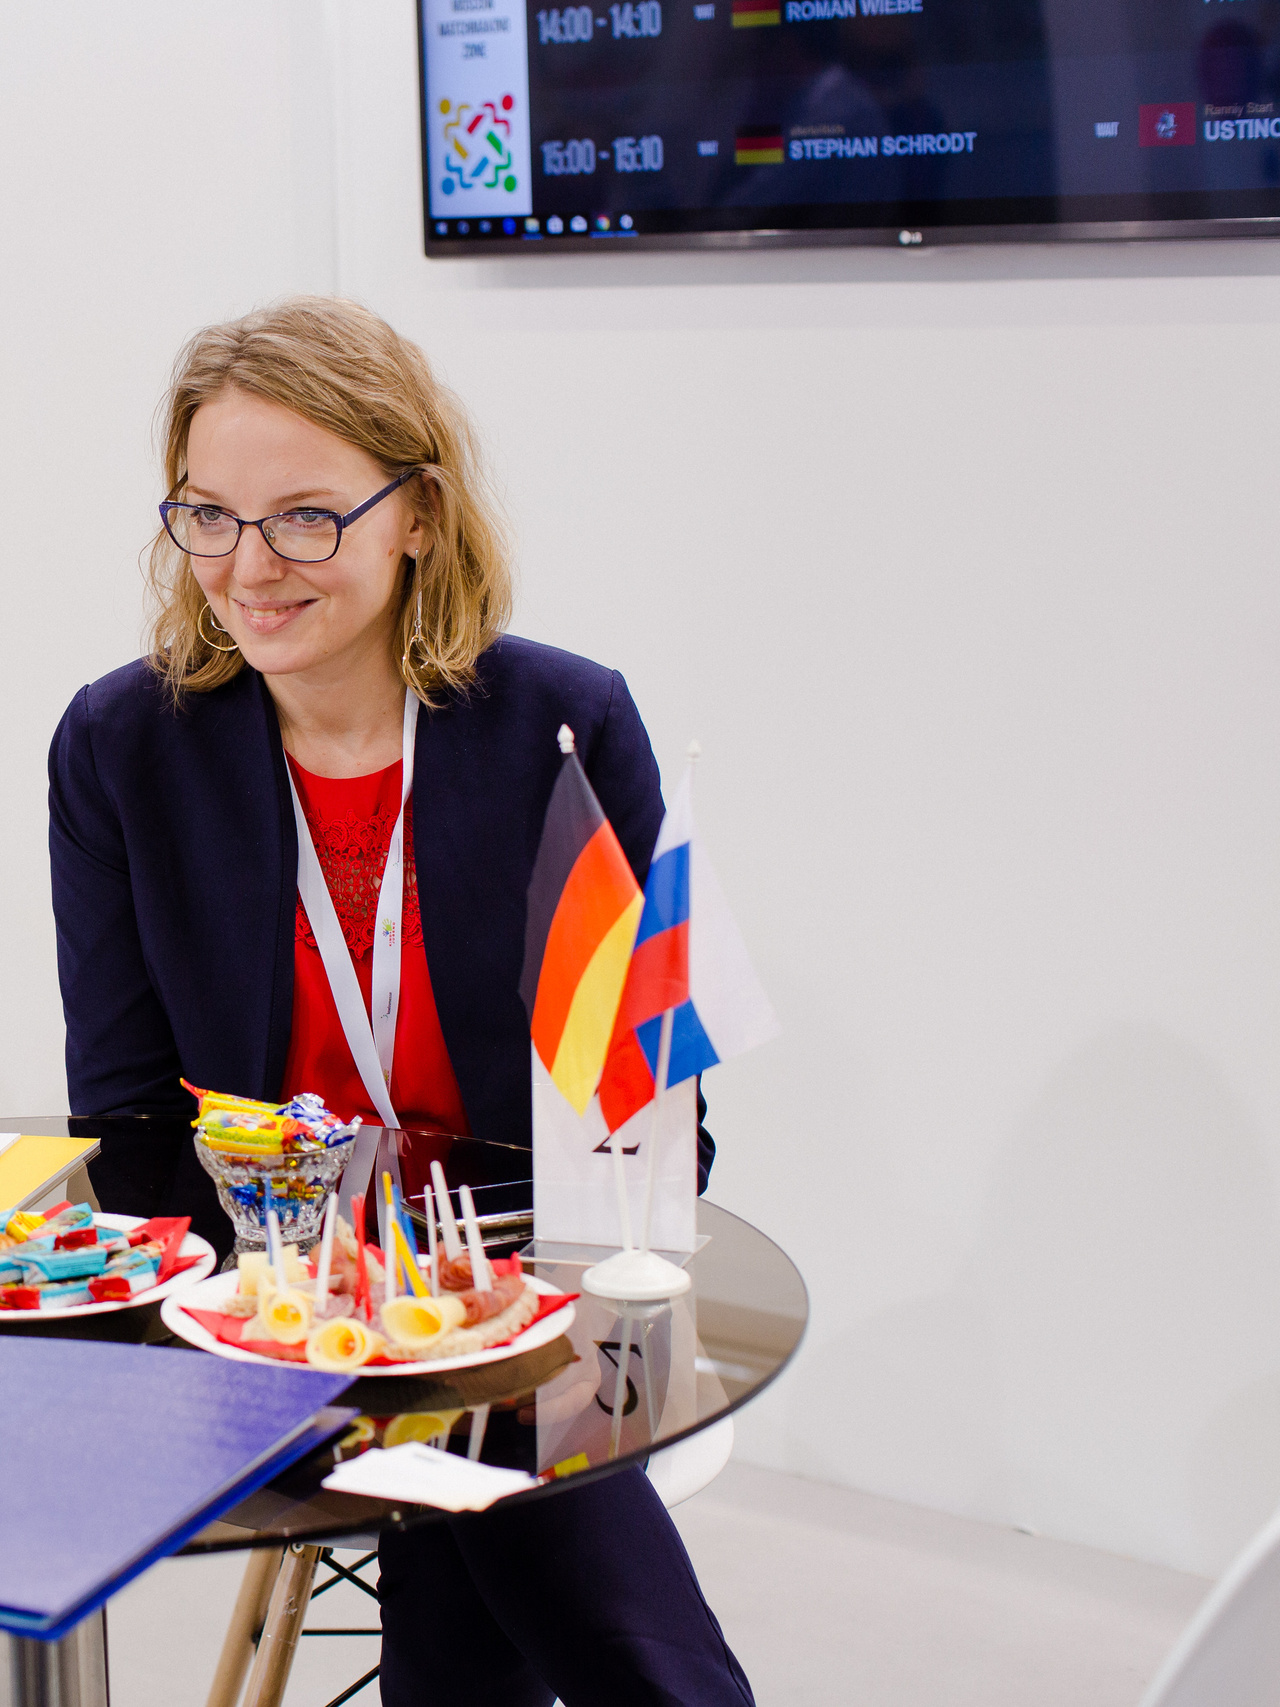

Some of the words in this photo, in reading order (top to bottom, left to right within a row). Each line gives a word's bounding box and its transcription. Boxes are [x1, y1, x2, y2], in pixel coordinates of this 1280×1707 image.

[537, 5, 593, 45] 14:00
[609, 1, 662, 39] 14:10
[786, 0, 857, 22] ROMAN
[541, 138, 596, 175] 15:00
[612, 134, 664, 173] 15:10
[789, 136, 878, 160] STEPHAN
[880, 131, 977, 155] SCHRODT
